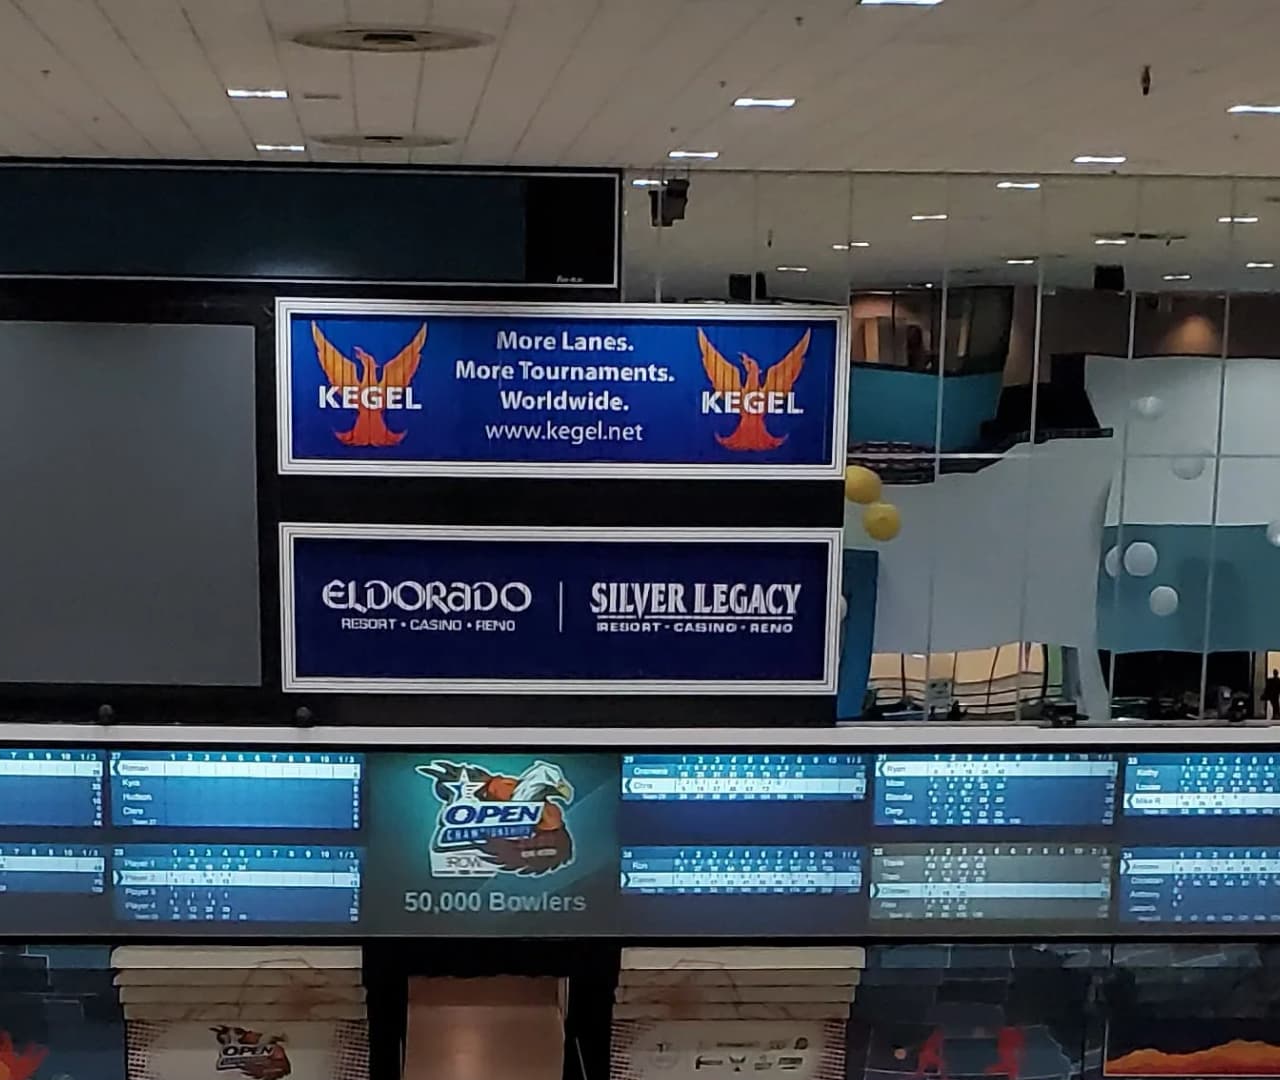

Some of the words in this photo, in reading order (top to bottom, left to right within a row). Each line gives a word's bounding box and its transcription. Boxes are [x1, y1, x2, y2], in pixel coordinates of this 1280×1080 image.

[496, 331, 556, 352] More
[562, 331, 634, 353] Lanes.
[455, 360, 515, 382] More
[520, 360, 675, 384] Tournaments.
[318, 385, 422, 410] KEGEL
[500, 390, 630, 412] Worldwide.
[701, 390, 804, 415] KEGEL
[485, 421, 643, 445] www.kegel.net
[590, 582, 686, 619] SILVER
[693, 583, 802, 616] LEGACY
[341, 617, 397, 631] RESORT
[409, 618, 462, 632] CASINO
[750, 622, 794, 634] RENO
[445, 805, 541, 825] OPEN
[404, 892, 482, 914] 50,000
[489, 892, 587, 912] Bowlers
